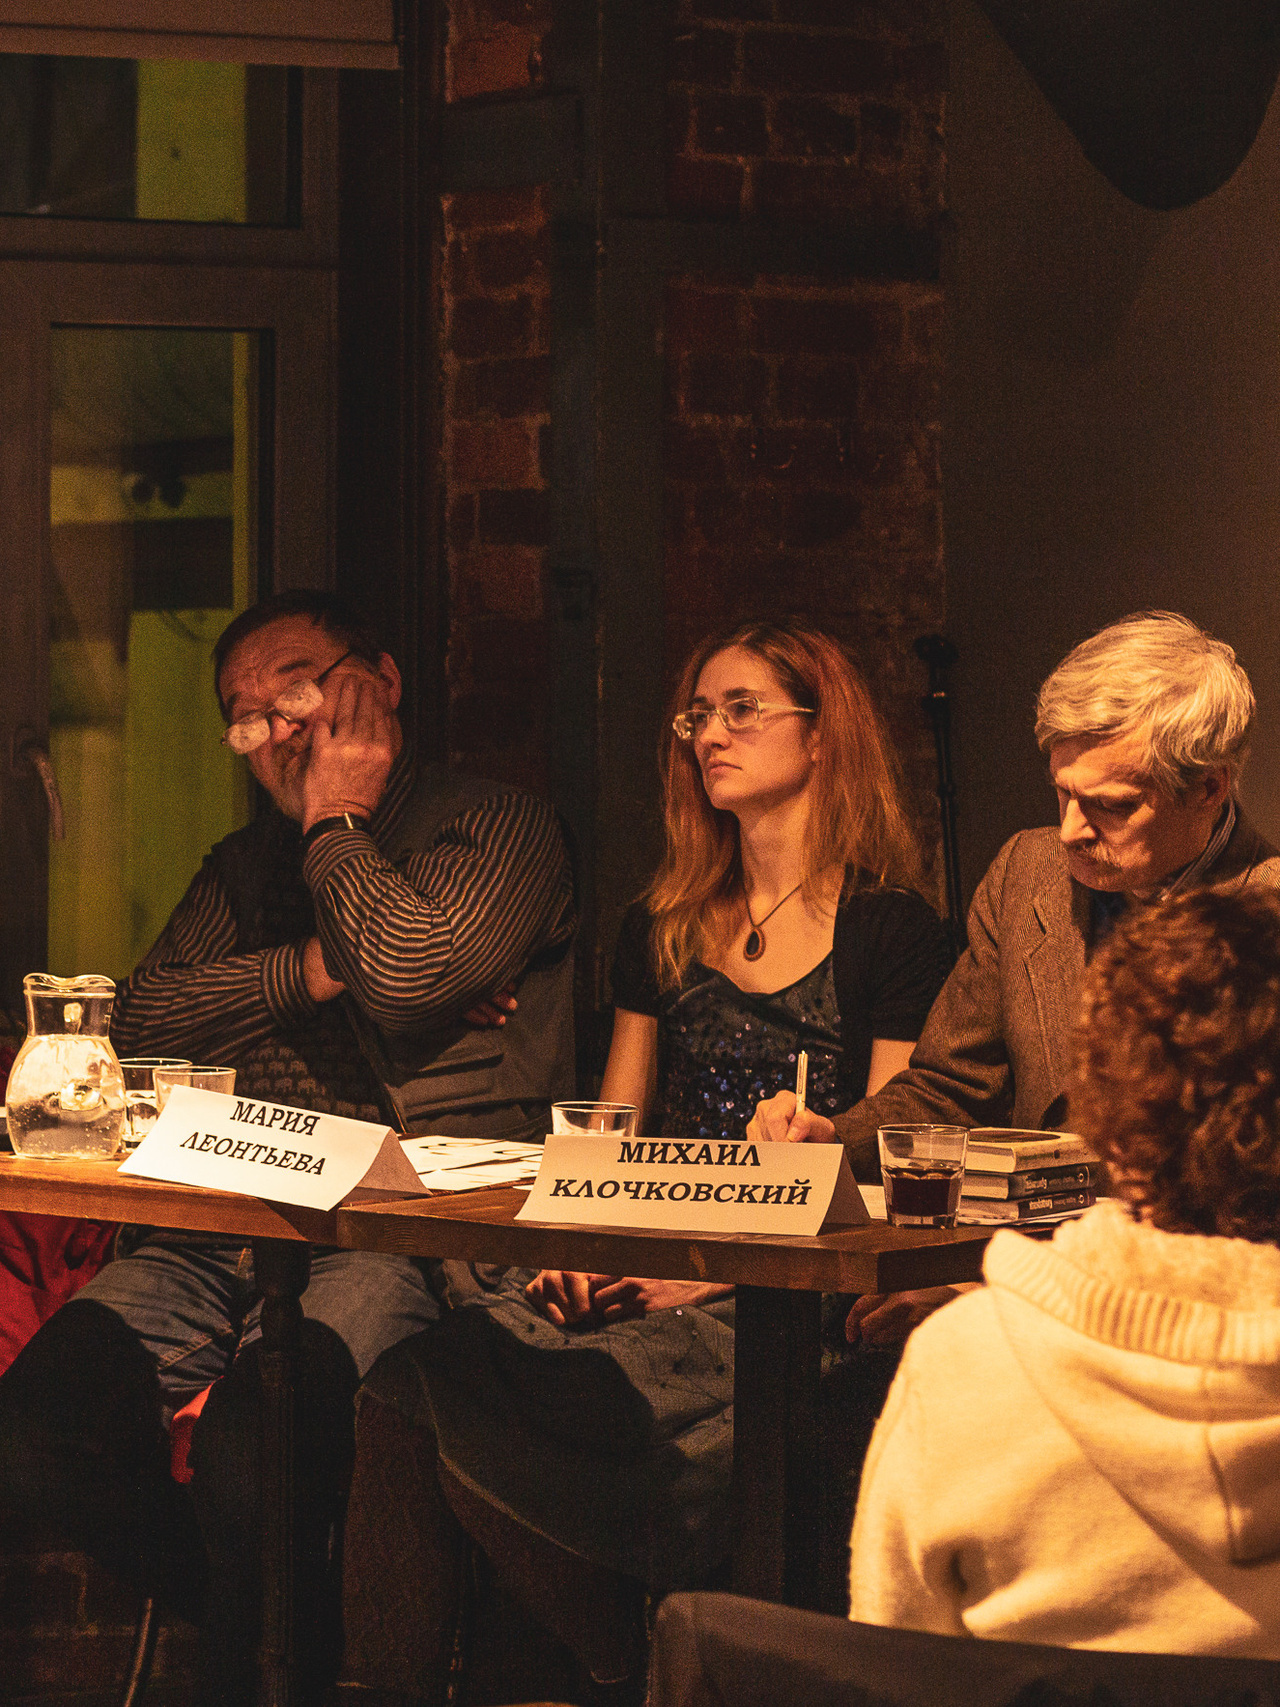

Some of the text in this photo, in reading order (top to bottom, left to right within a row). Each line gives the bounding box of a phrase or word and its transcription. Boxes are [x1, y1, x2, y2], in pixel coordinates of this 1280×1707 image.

[229, 1100, 321, 1136] МАРИЯ
[179, 1131, 327, 1176] ЛЕОНТЬЕВА
[616, 1141, 762, 1167] МИХАИЛ
[548, 1178, 813, 1206] КЛОЧКОВСКИЙ
